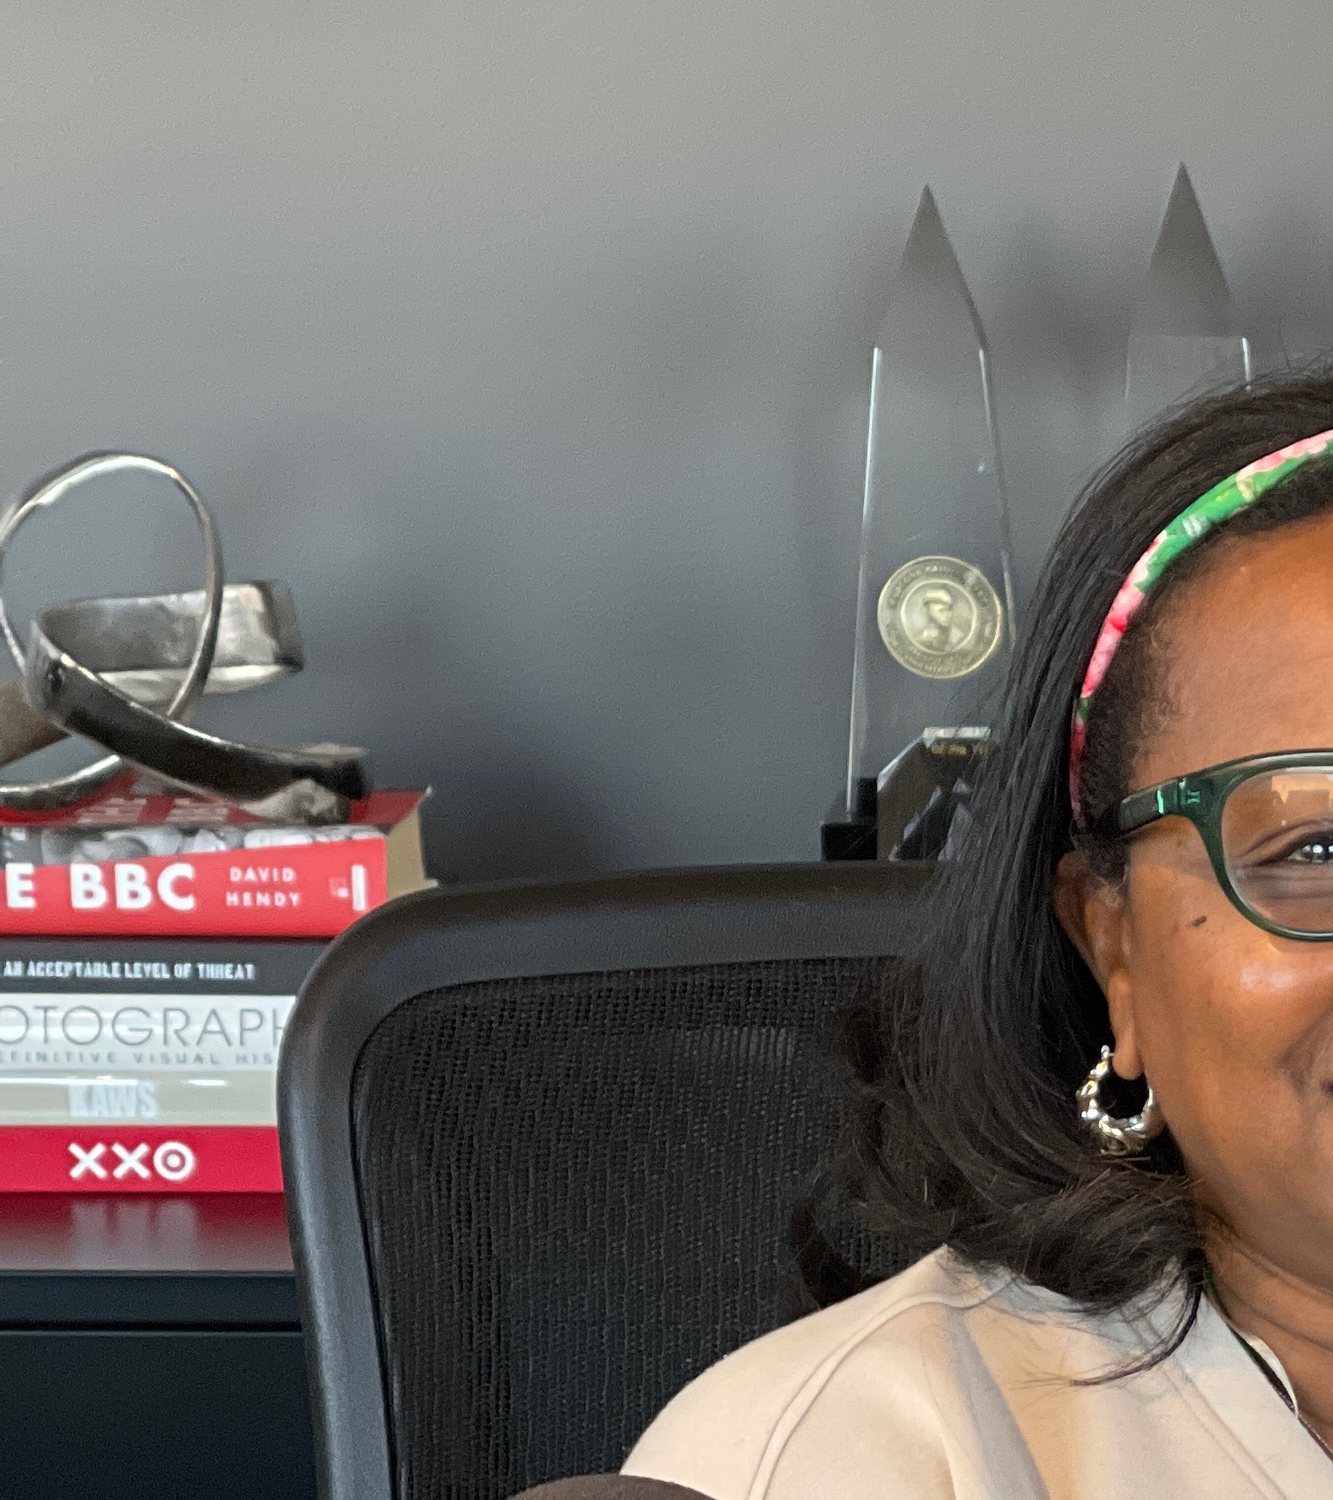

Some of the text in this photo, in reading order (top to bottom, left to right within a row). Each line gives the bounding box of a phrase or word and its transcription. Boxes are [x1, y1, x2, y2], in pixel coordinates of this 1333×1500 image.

[229, 865, 297, 884] DAVID
[70, 862, 196, 911] BBC
[225, 890, 303, 908] HENDY
[3, 960, 256, 980] AN ACCEPTABLE LEVEL OF THREAT
[133, 1051, 221, 1065] VISUAL
[67, 1080, 160, 1119] KAWS
